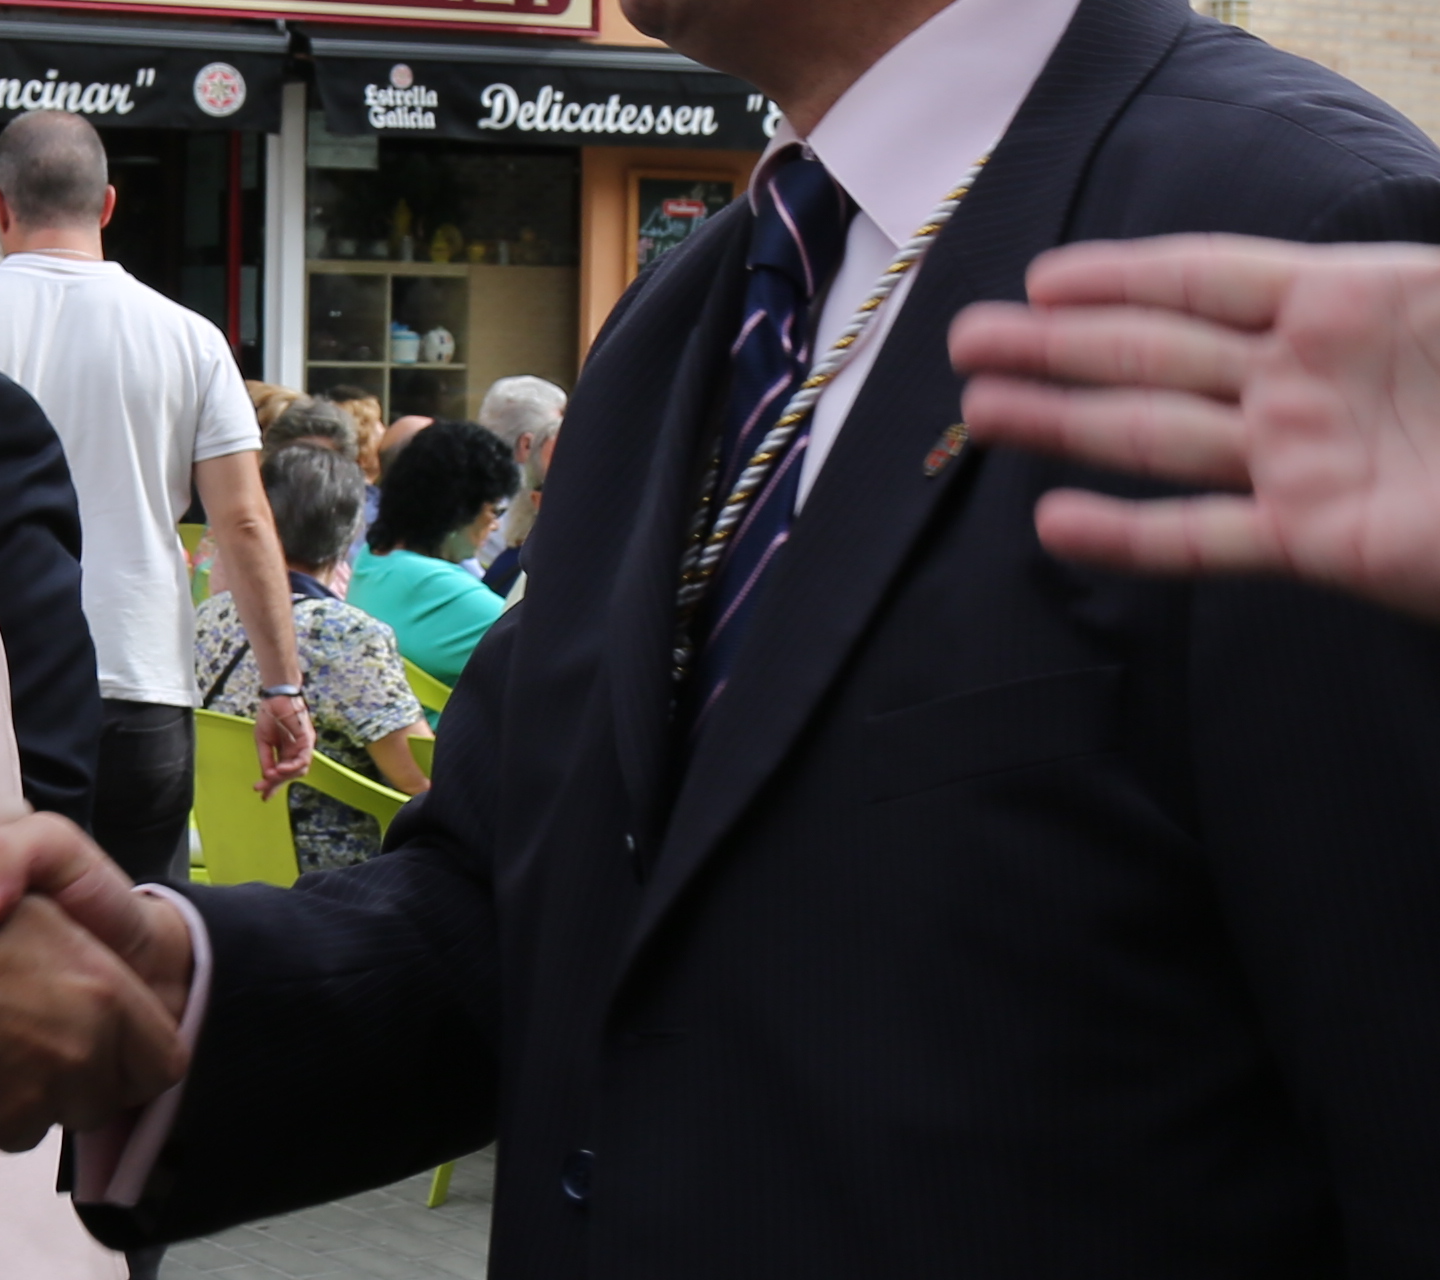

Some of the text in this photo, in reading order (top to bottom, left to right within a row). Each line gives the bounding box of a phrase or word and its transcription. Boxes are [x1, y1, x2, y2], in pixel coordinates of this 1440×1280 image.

[364, 84, 439, 108] Estrella
[367, 106, 437, 130] Galicia
[477, 82, 719, 136] Delicatessen
